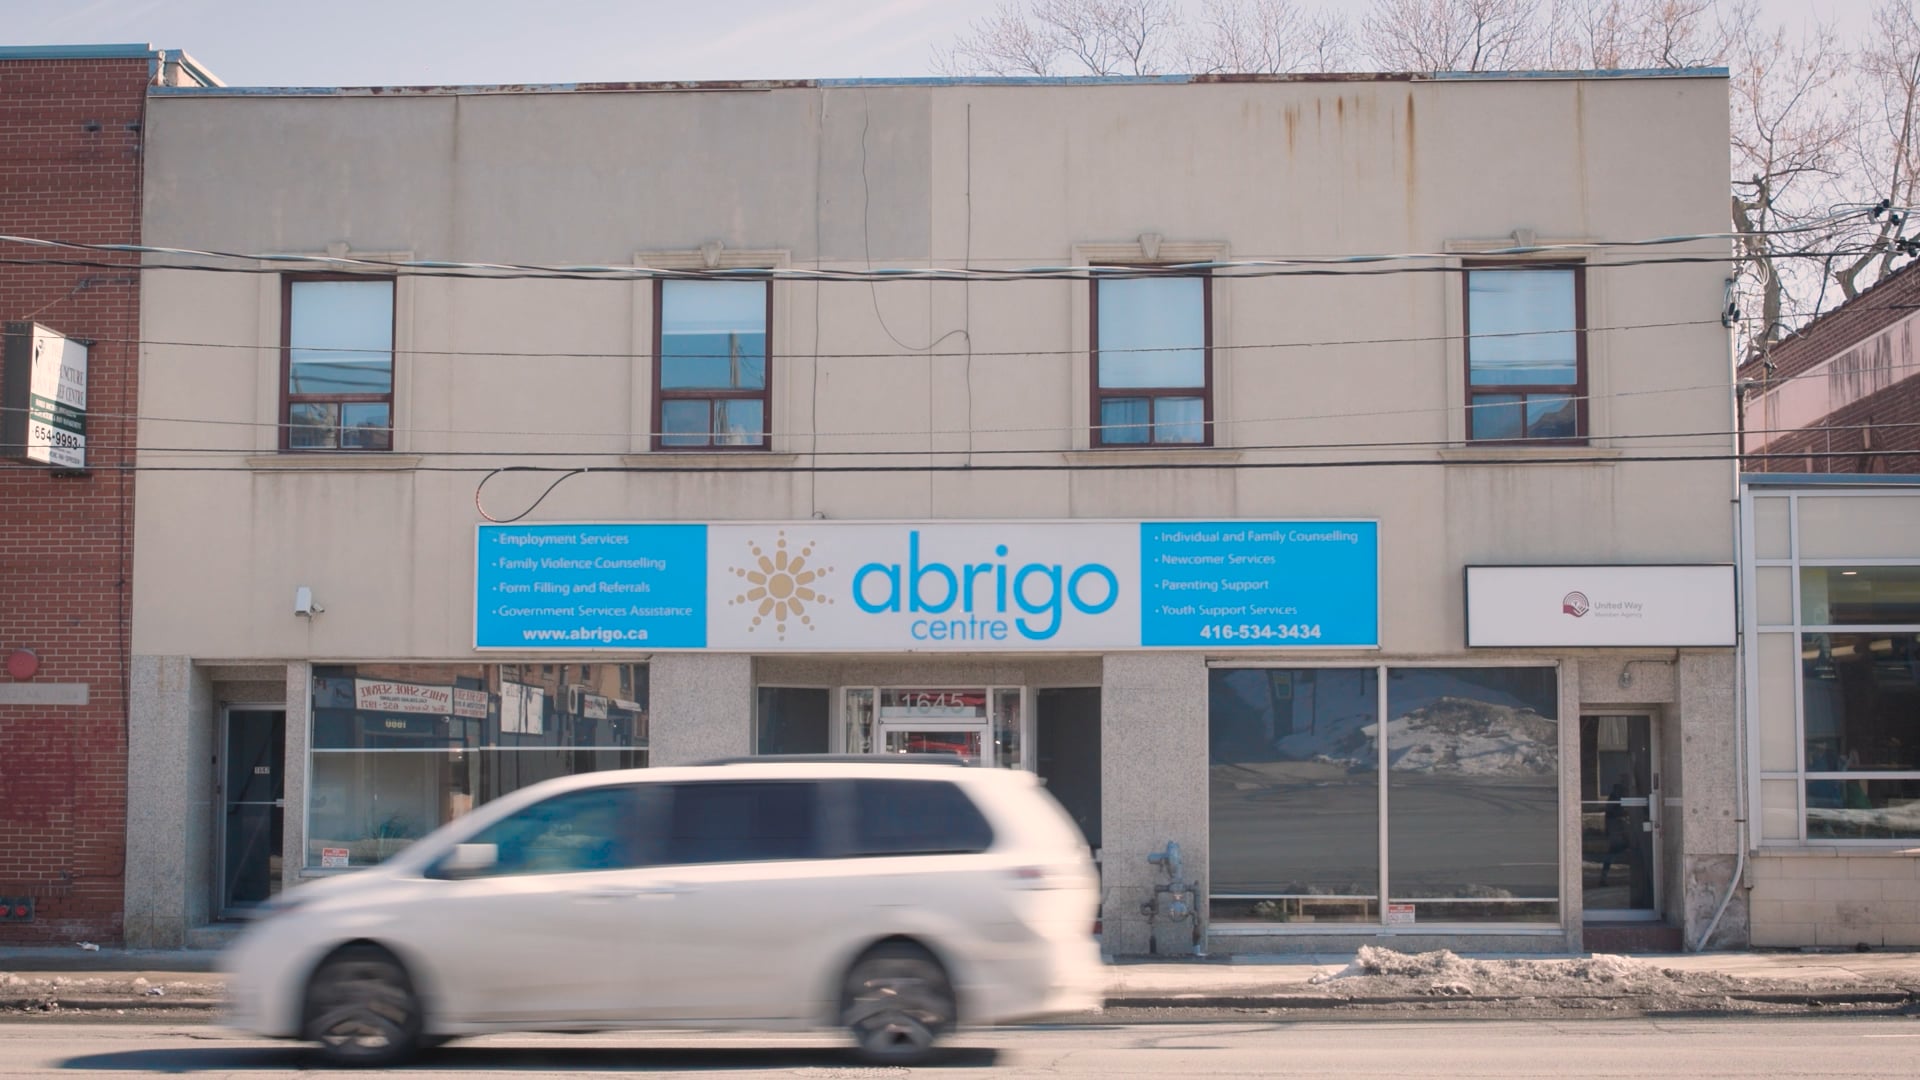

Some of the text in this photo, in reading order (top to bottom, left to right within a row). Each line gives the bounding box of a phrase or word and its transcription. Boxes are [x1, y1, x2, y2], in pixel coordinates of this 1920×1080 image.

[499, 533, 629, 547] Employment Services
[1162, 530, 1359, 544] Individual and Family Counselling
[499, 557, 667, 571] Family Violence Counselling
[1162, 553, 1275, 565] Newcomer Services
[499, 582, 650, 596] Form Filling and Referrals
[852, 530, 1119, 641] abrigo
[1162, 579, 1269, 593] Parenting Support
[499, 605, 692, 617] Government Services Assistance
[1162, 605, 1297, 617] Youth Support Services
[1594, 601, 1643, 611] United Way
[523, 626, 649, 643] www.abrigo.ca
[911, 615, 1008, 640] centre
[1200, 623, 1322, 640] 416-534-3434
[902, 692, 965, 714] 1645
